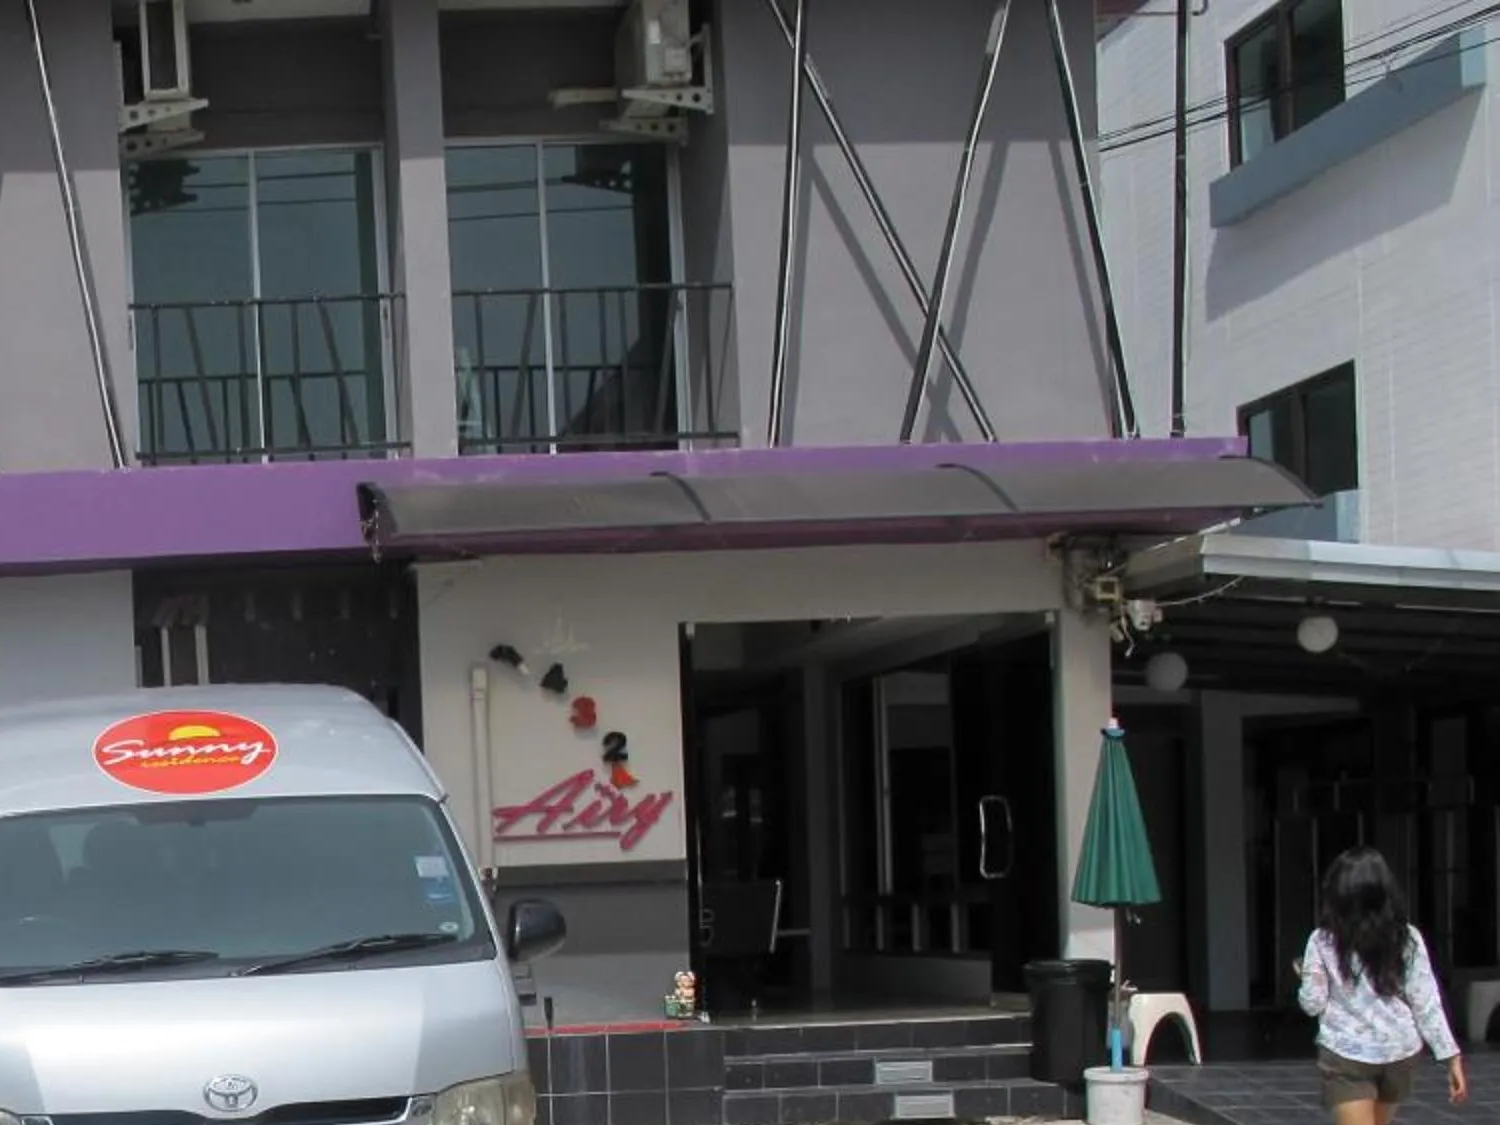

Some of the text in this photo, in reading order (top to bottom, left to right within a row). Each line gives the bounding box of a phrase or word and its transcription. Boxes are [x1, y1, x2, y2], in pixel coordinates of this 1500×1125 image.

[101, 739, 272, 765] Sunny
[568, 696, 597, 729] 3
[602, 731, 628, 763] 2
[492, 767, 674, 852] Airy
